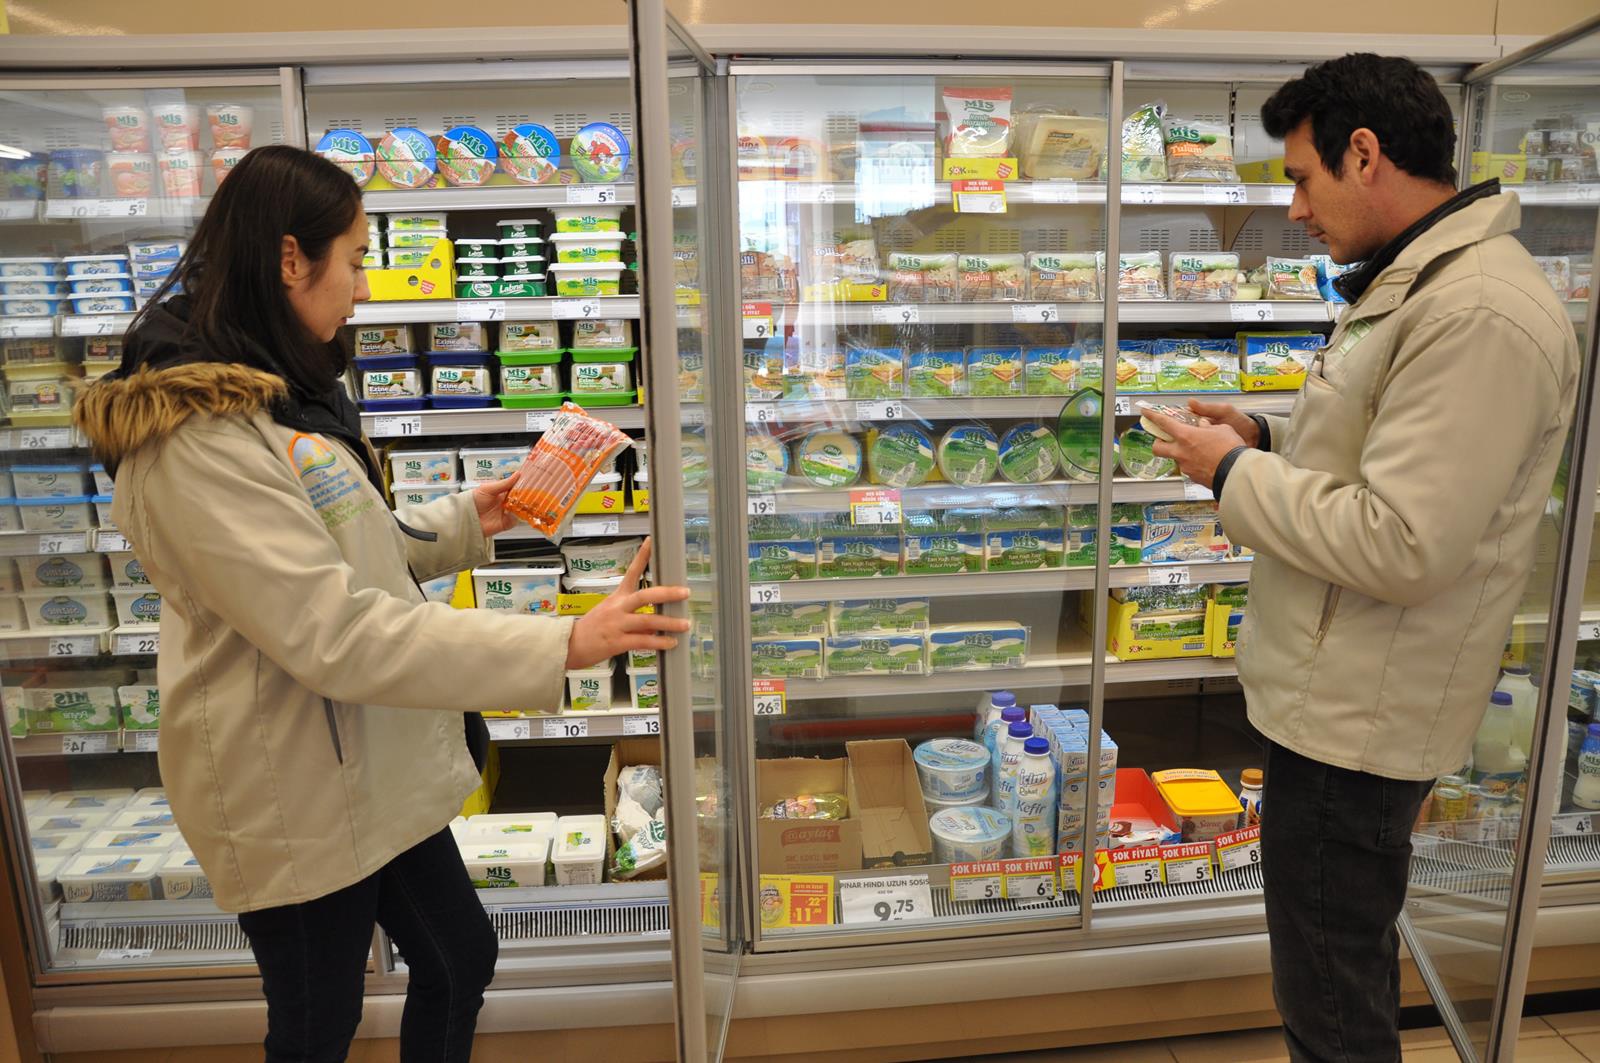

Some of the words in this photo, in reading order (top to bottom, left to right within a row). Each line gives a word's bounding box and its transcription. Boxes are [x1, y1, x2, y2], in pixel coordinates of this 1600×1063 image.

[1171, 144, 1202, 154] Tulum
[598, 192, 606, 202] 5
[128, 205, 137, 215] 5
[500, 283, 524, 295] Labne
[489, 309, 496, 320] 7
[583, 305, 591, 316] 9
[902, 311, 911, 322] 9
[1042, 310, 1050, 321] 9
[1258, 310, 1265, 320] 9
[98, 323, 106, 334] 7
[756, 325, 765, 336] 9
[757, 410, 766, 421] 8
[886, 407, 894, 418] 8
[401, 423, 412, 434] 11
[752, 502, 767, 514] 19
[877, 511, 893, 523] 14
[602, 523, 609, 534] 7
[1167, 573, 1181, 584] 27
[757, 590, 772, 602] 19
[139, 640, 155, 652] 22
[757, 702, 774, 714] 26
[514, 726, 522, 738] 9
[564, 725, 579, 738] 10
[645, 721, 659, 733] 13
[1016, 801, 1047, 815] Kefir
[1576, 821, 1585, 833] 4
[1216, 835, 1235, 847] ŞOK
[1112, 851, 1130, 862] ŞOK
[1131, 847, 1159, 859] FİYAT!
[1162, 849, 1180, 860] ŞOK
[1181, 845, 1208, 857] FİYAT!
[1250, 850, 1258, 862] 8
[952, 864, 971, 875] ŞOK
[972, 861, 1000, 873] FİYAT!
[1005, 863, 1025, 874] ŞOK
[1025, 860, 1052, 872] FİYAT!
[1196, 867, 1204, 879] 5
[1144, 869, 1152, 882] 5
[985, 885, 993, 897] 5
[1037, 882, 1045, 895] 6
[796, 907, 811, 921] 11
